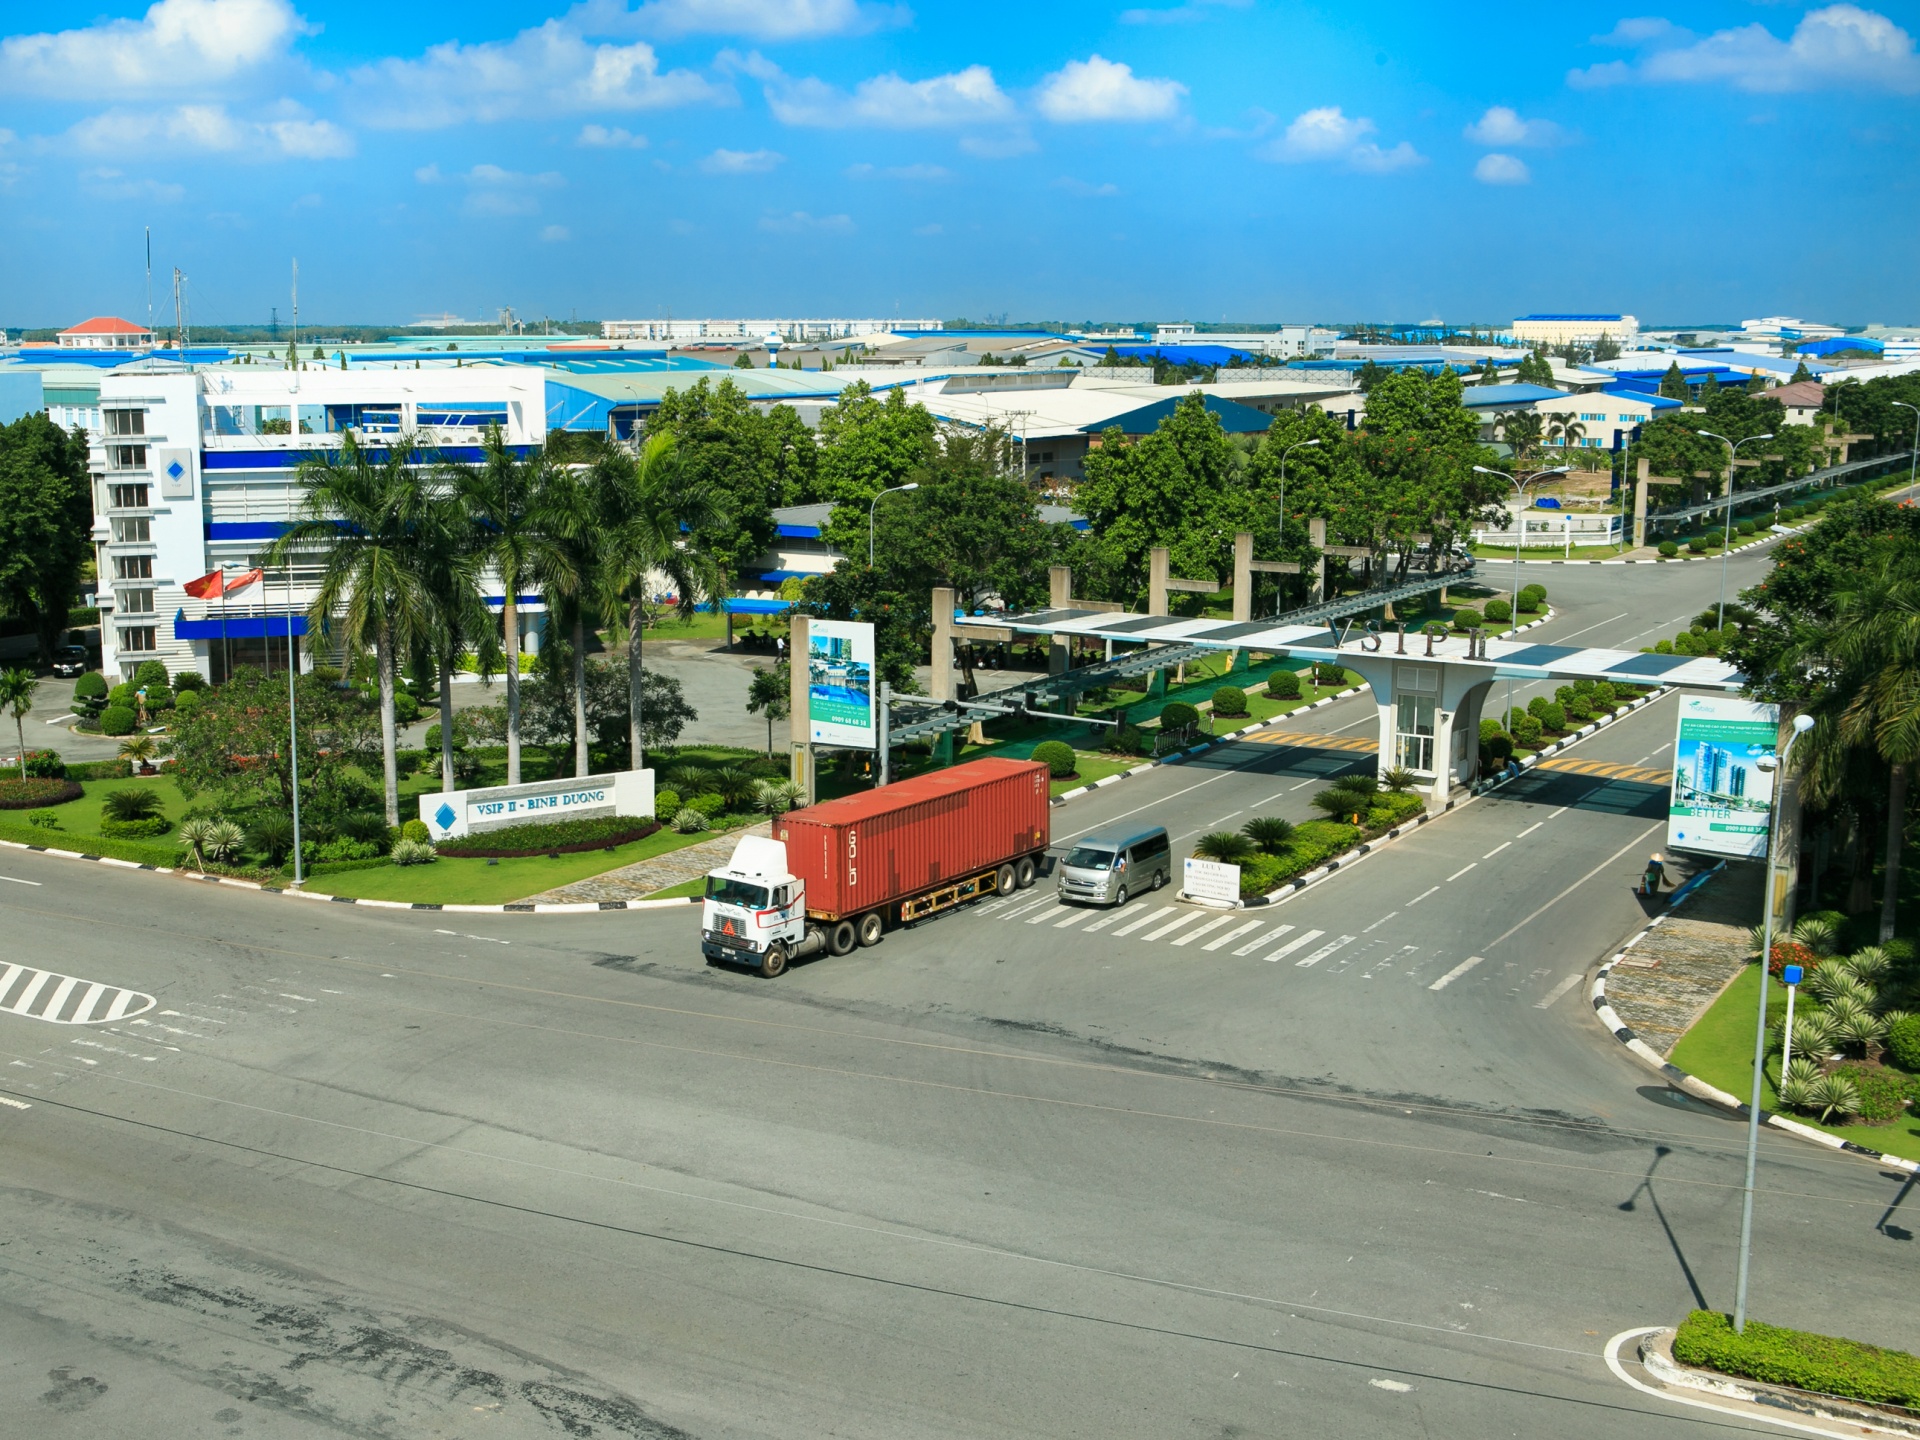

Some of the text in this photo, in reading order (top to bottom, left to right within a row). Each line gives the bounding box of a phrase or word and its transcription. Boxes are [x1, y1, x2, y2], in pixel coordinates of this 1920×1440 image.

[1327, 617, 1449, 657] VSIP
[831, 715, 844, 723] 0909
[477, 802, 505, 815] VSIP
[527, 796, 558, 810] BINH
[562, 790, 605, 806] DUONG
[1690, 808, 1731, 819] BETTER
[848, 830, 857, 887] GOLD
